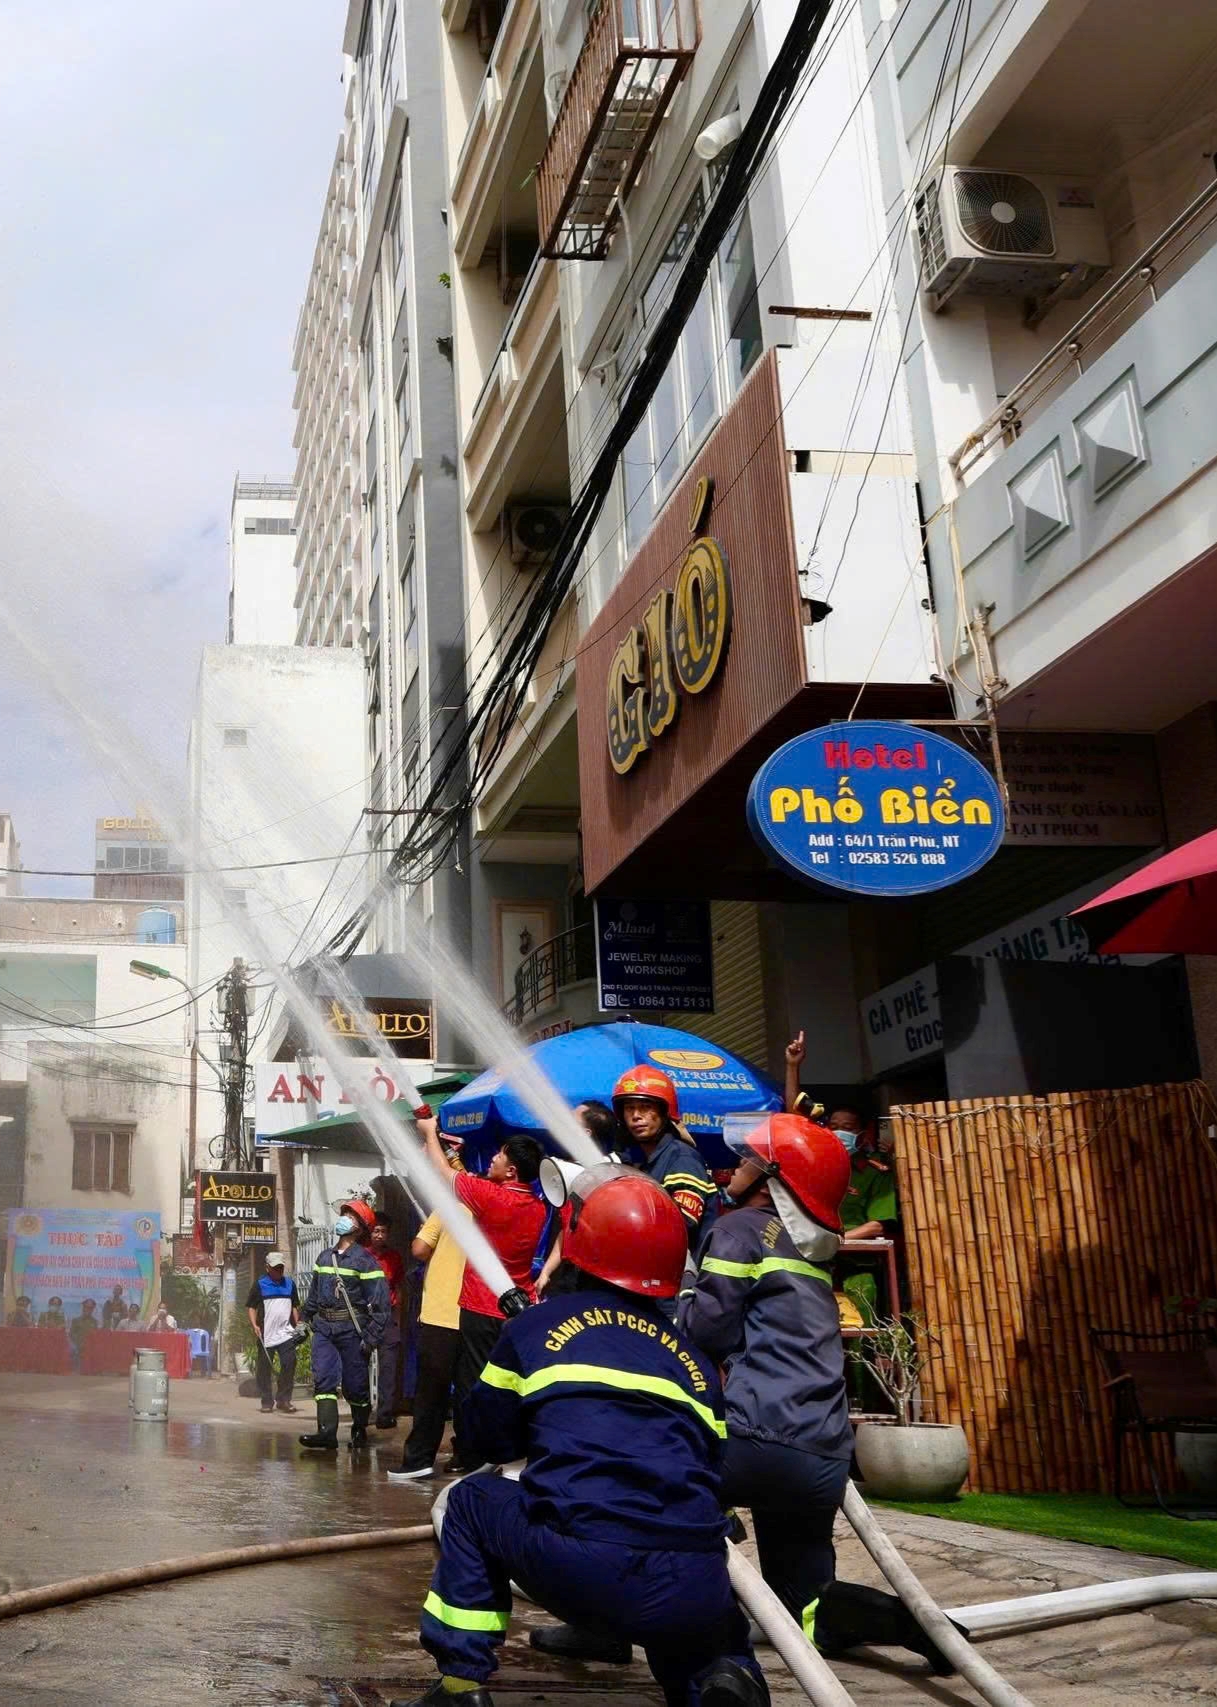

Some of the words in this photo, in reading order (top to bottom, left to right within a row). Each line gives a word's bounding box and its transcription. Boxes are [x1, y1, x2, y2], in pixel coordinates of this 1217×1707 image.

[824, 740, 928, 769] Hotel
[769, 775, 864, 823] Phố
[880, 777, 992, 825] Biển
[1011, 823, 1037, 838] TẠI
[1041, 823, 1100, 837] TPHCM
[808, 833, 834, 847] Add
[844, 834, 874, 847] 64/1
[943, 834, 960, 848] NT
[809, 851, 830, 864] Tel
[848, 852, 890, 865] 02583
[893, 853, 918, 865] 526
[920, 853, 946, 865] 888
[607, 952, 657, 962] JEWELRY
[659, 953, 704, 964] MAKING
[623, 964, 688, 976] WORKSHOP
[602, 983, 616, 991] 2ND
[616, 984, 639, 992] FLOOR
[638, 995, 665, 1007] 0964
[668, 996, 680, 1007] 31
[683, 997, 696, 1008] 51
[697, 997, 711, 1008] 31
[868, 999, 893, 1036] CÀ
[893, 980, 929, 1025] PHÊ
[267, 1073, 325, 1104] AN
[202, 1175, 272, 1199] APOLLO
[216, 1206, 259, 1218] HOTEL
[544, 1316, 585, 1352] CẢNH
[583, 1307, 613, 1326] SÁT
[616, 1311, 658, 1338] PCCC
[660, 1330, 680, 1353] VÀ
